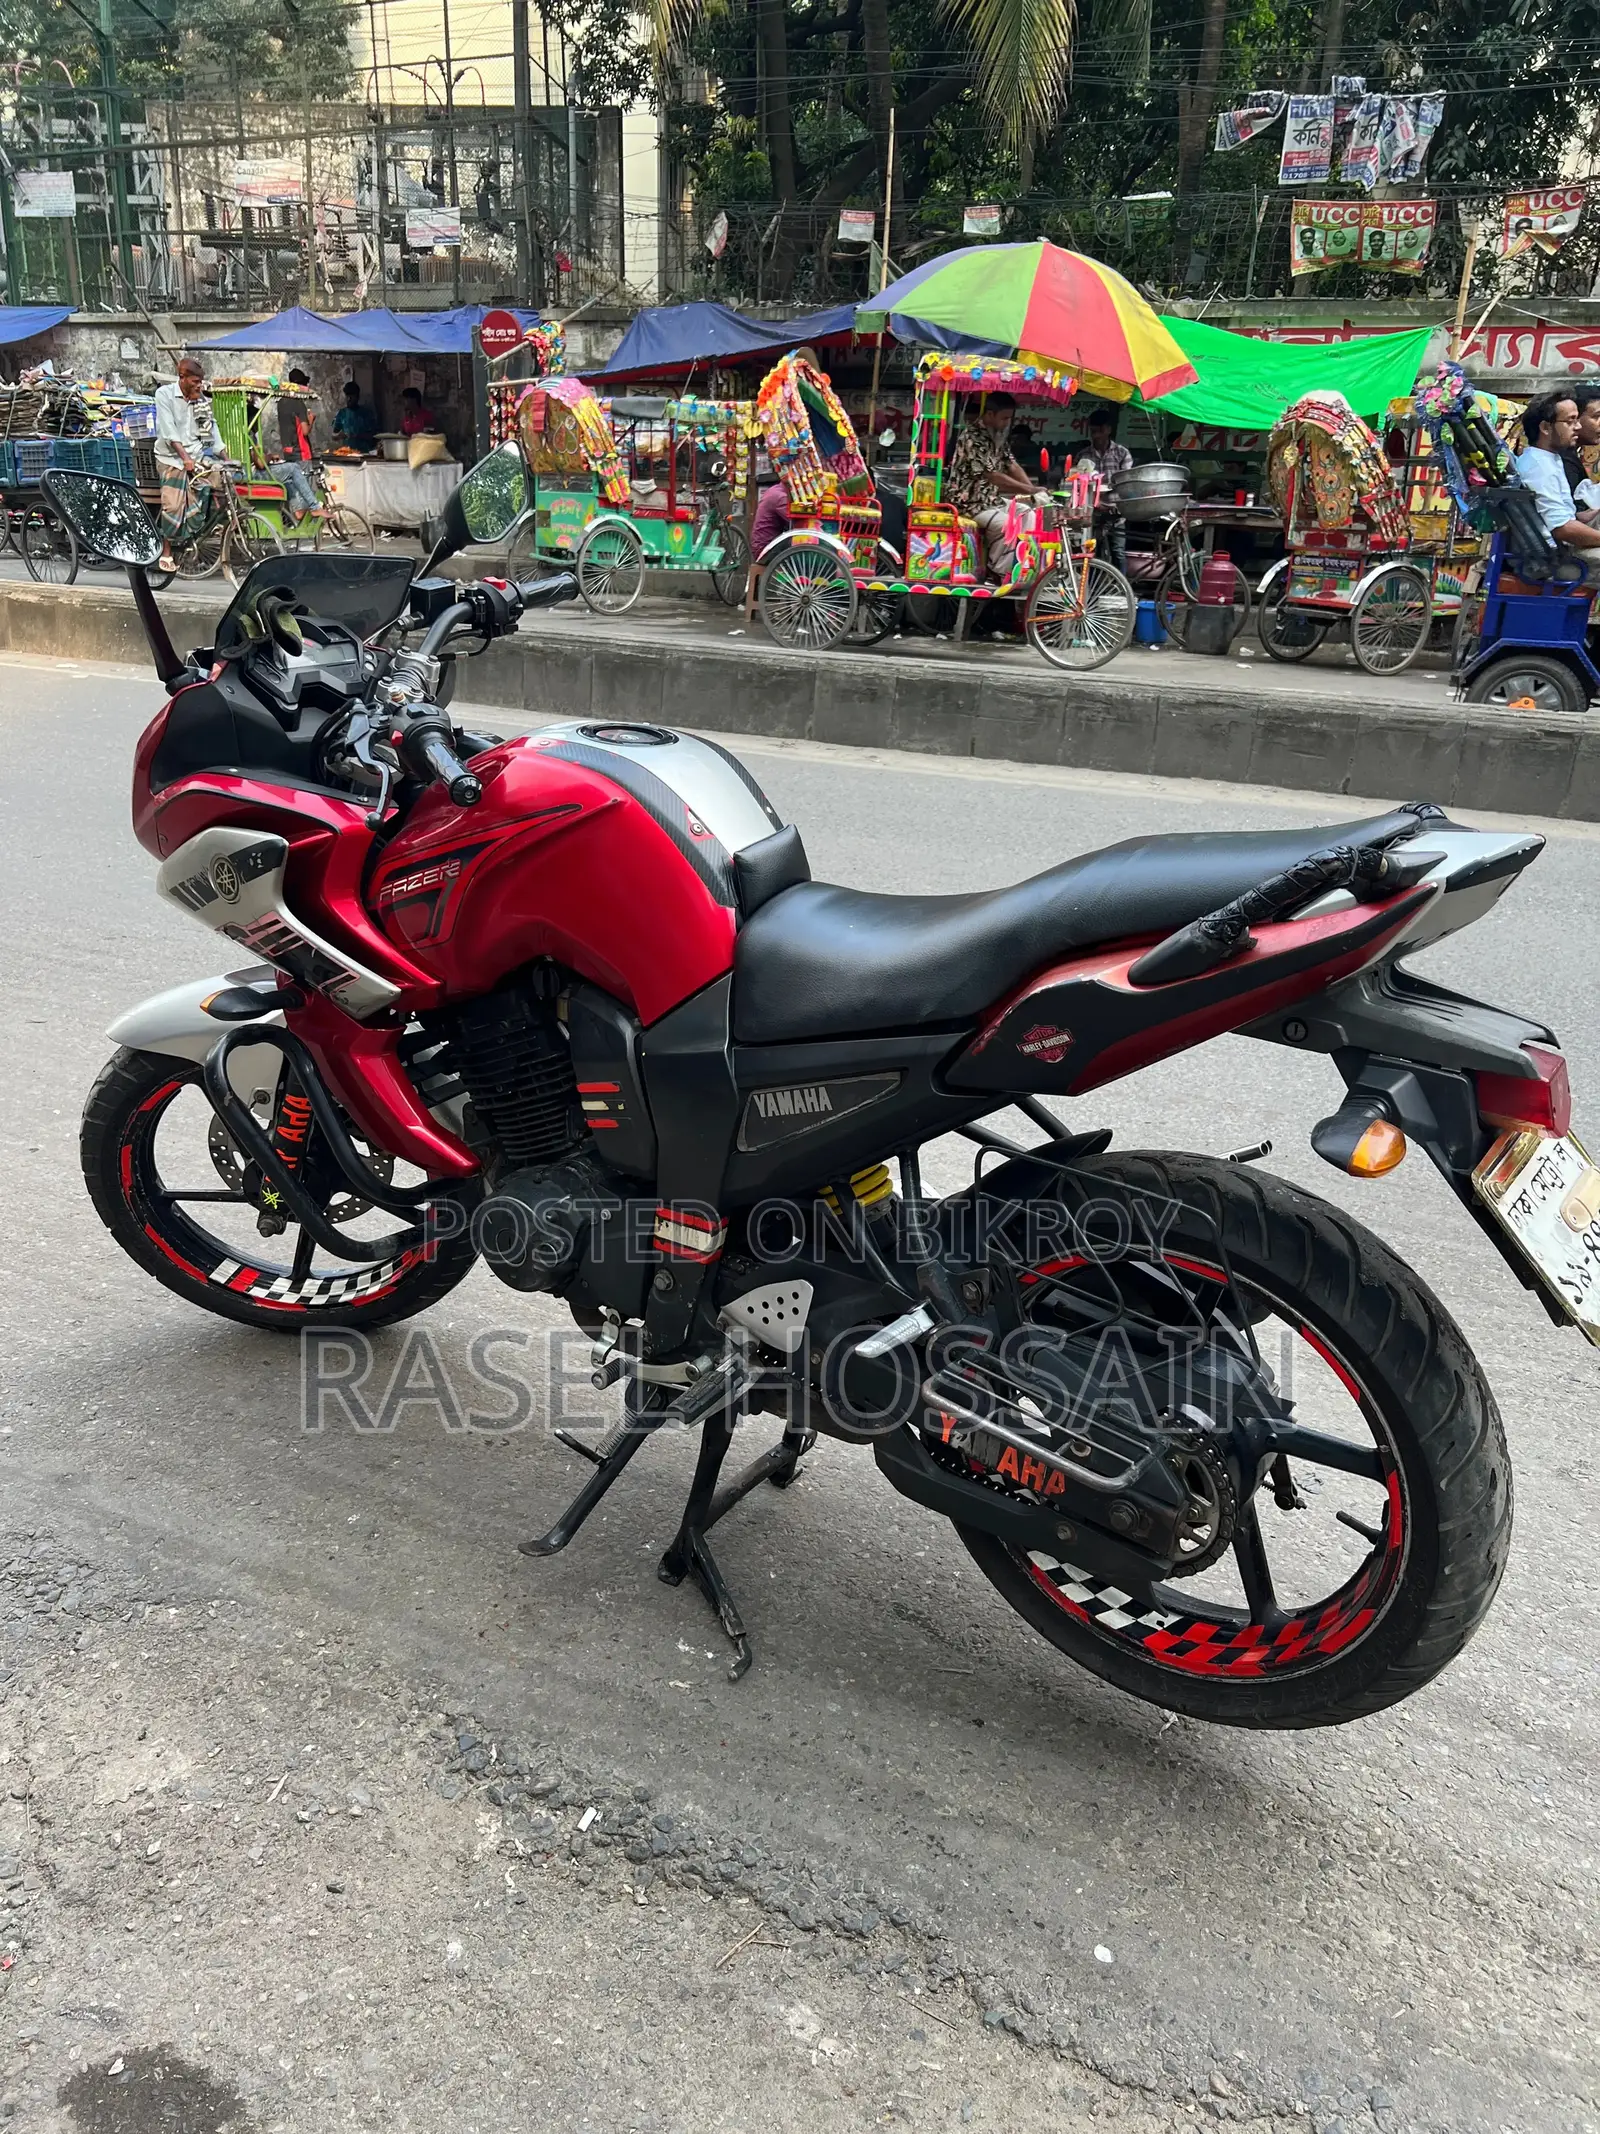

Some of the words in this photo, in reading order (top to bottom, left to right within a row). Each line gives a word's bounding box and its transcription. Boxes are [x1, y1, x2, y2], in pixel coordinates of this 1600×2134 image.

[1528, 189, 1582, 211] UCC
[1311, 206, 1360, 225] UCC
[1382, 205, 1433, 224] UCC
[380, 860, 461, 902] FAZER
[1021, 1033, 1071, 1053] HARLEY-DAVIDSON
[753, 1086, 833, 1118] YAMAHA
[1507, 1188, 1540, 1230] ঢাকা
